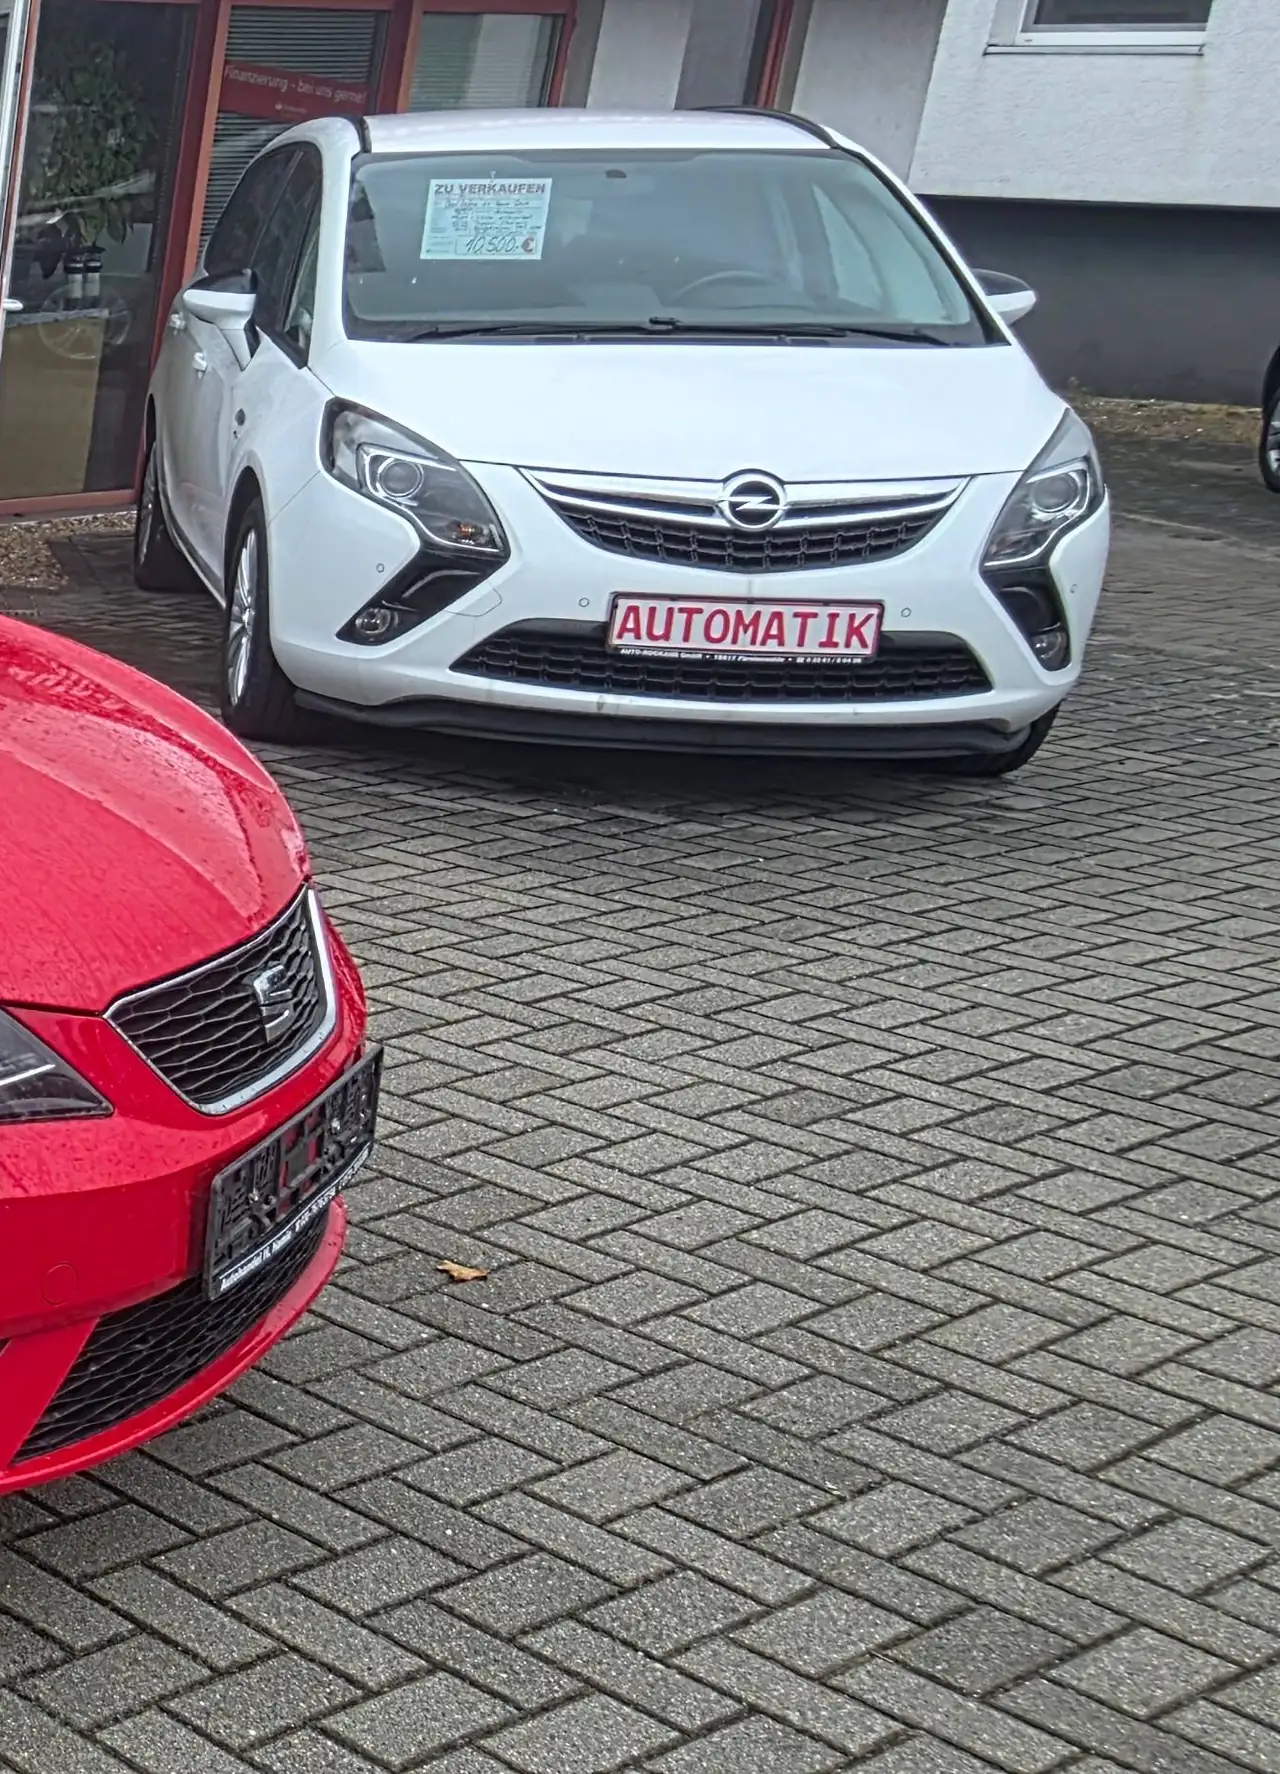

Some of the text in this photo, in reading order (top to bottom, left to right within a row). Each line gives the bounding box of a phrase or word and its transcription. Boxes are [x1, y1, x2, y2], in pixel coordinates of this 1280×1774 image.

[434, 183, 546, 195] ZU VERKAUFEN
[616, 605, 875, 649] AUTOMATIK
